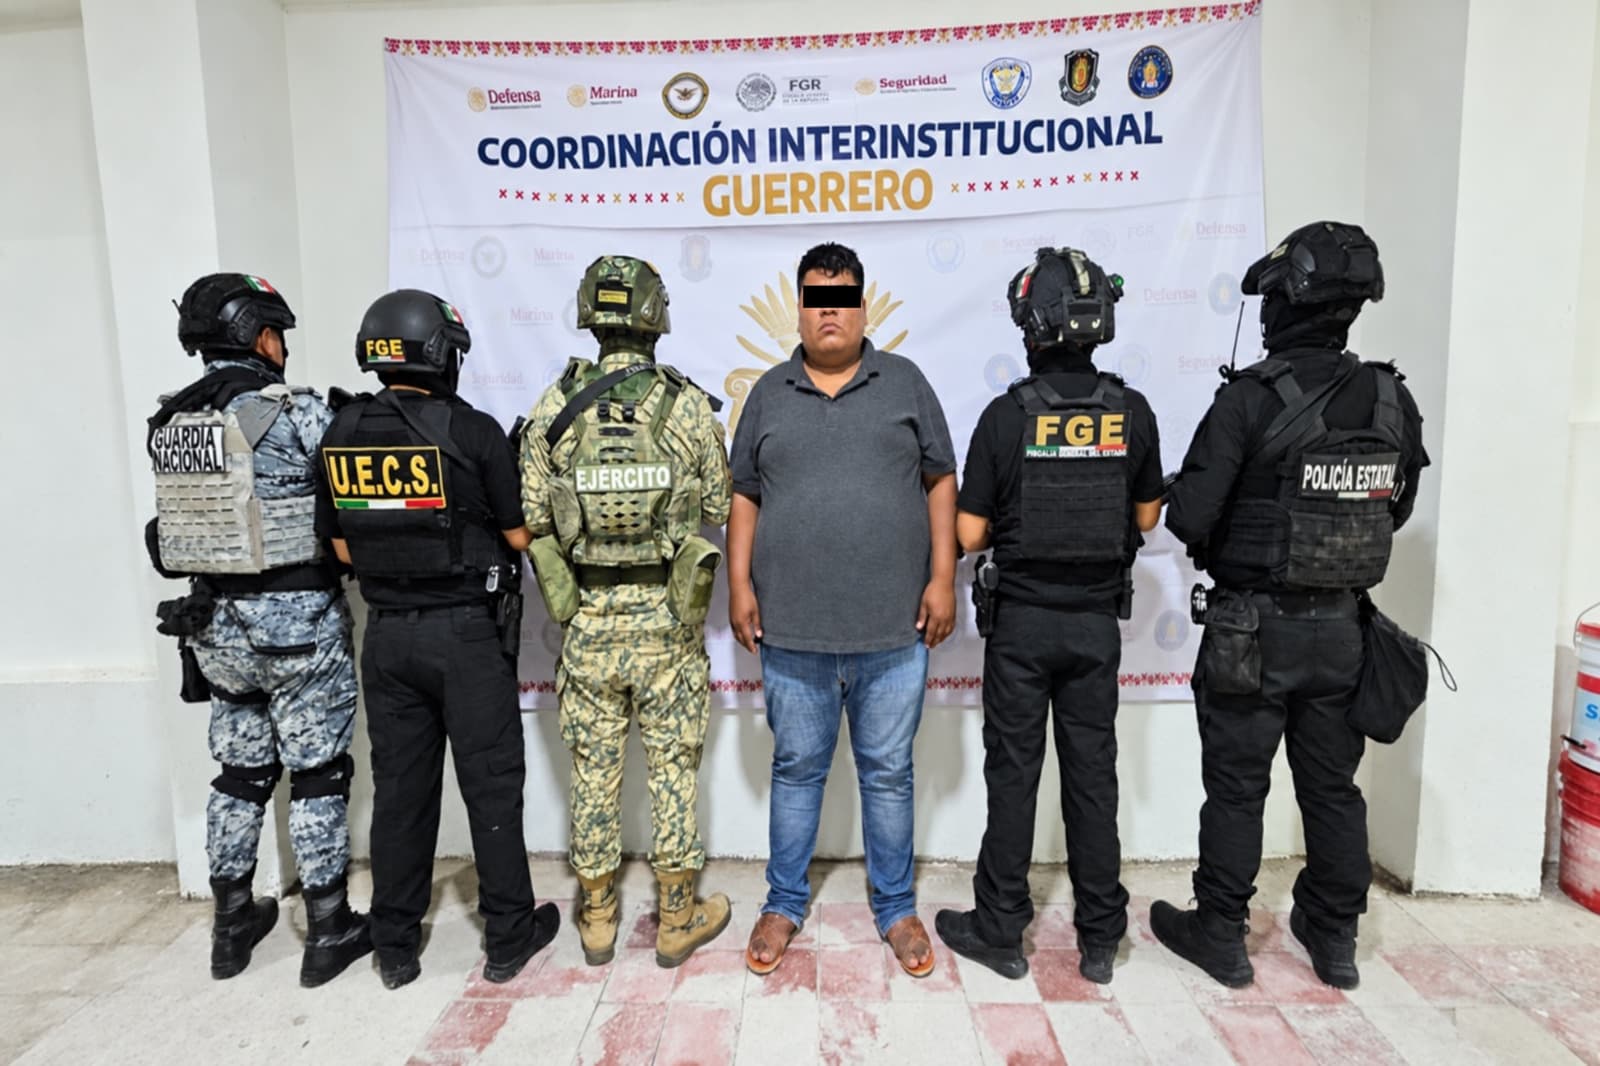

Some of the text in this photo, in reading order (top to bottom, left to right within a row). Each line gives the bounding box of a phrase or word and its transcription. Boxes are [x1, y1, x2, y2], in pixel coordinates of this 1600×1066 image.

[789, 78, 822, 91] FGR
[879, 73, 947, 89] Seguridad
[488, 88, 541, 105] Defensa
[590, 86, 637, 100] Marina
[477, 111, 1163, 169] COORDINACIÓN INTERINSTITUCIONAL
[702, 168, 933, 217] GUERRERO
[1196, 221, 1246, 236] Defensa
[1143, 288, 1198, 303] Defensa
[511, 307, 554, 322] Marina
[365, 339, 404, 356] FGE
[1036, 414, 1124, 446] FGE
[153, 447, 222, 472] NACIONAL
[328, 454, 440, 496] U.E.C.S.
[576, 464, 671, 491] EJÉRCITO
[1302, 458, 1396, 490] POLICÍA ESTATAL
